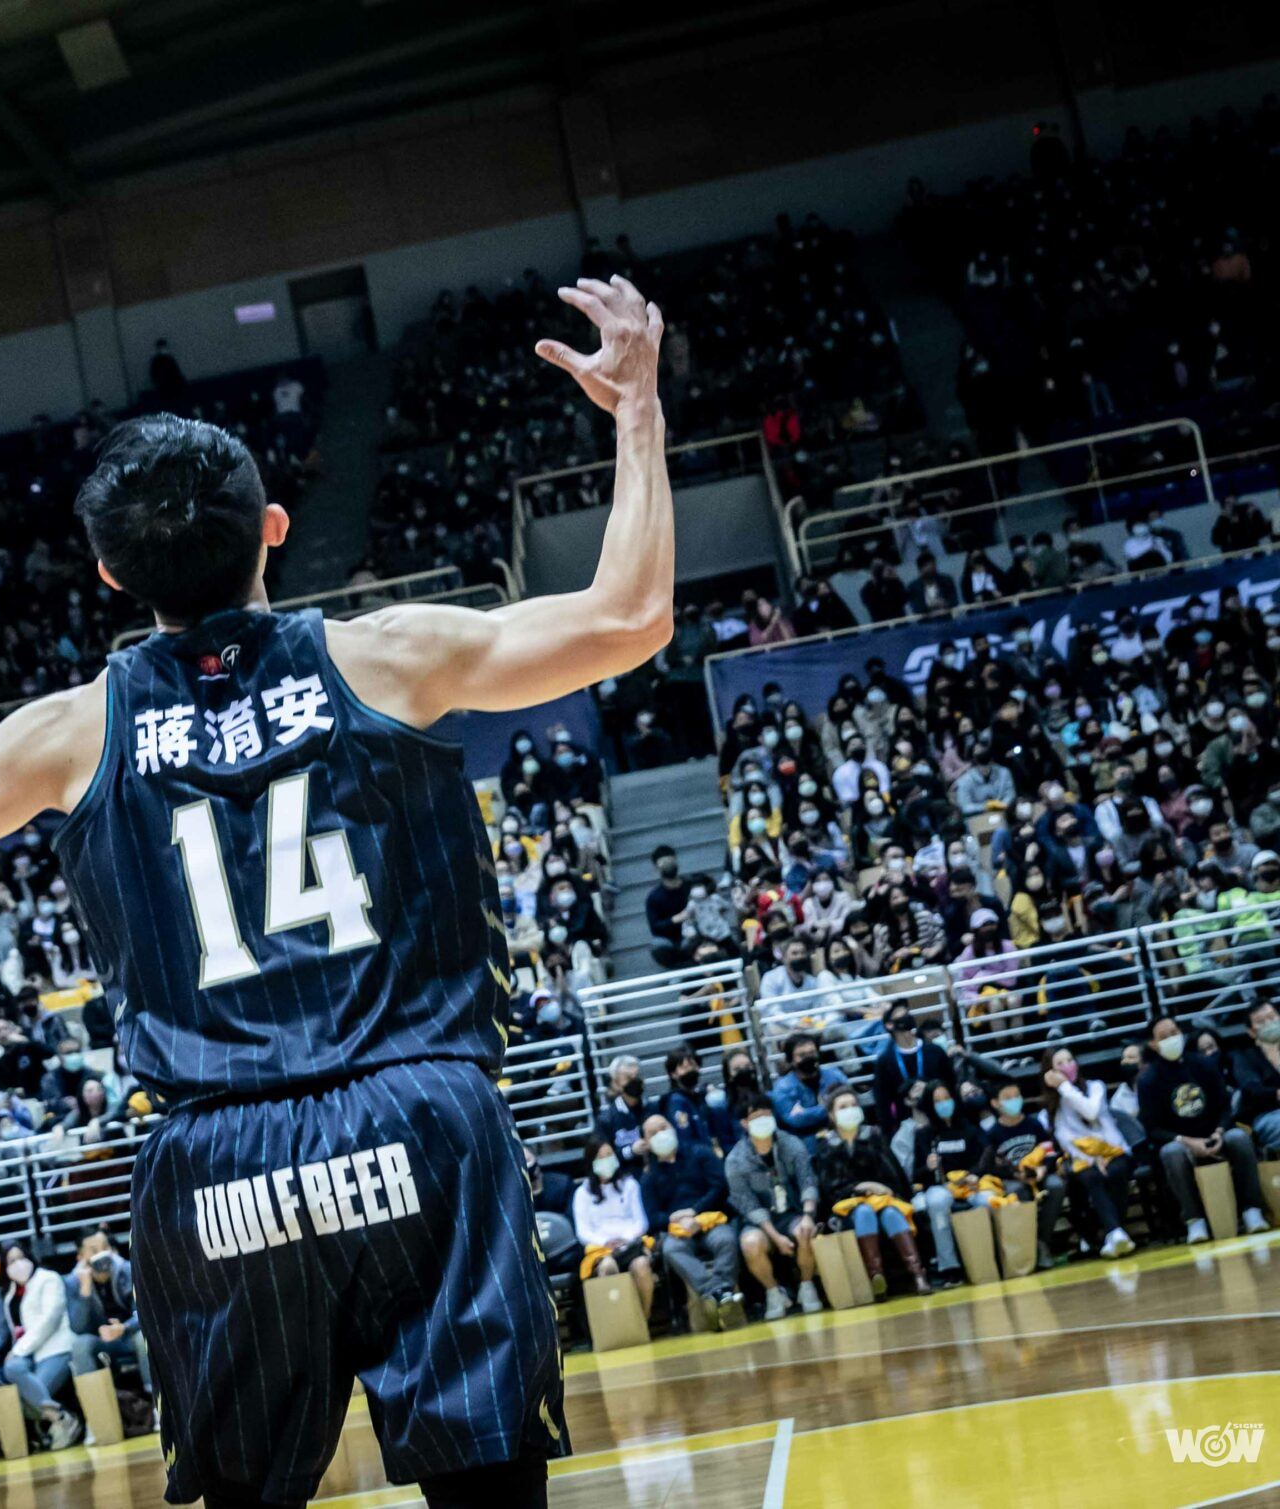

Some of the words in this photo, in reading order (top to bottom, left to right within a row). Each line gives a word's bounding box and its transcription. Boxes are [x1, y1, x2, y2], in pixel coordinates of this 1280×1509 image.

[134, 673, 335, 776] 蔣淯安
[171, 772, 382, 991] 14
